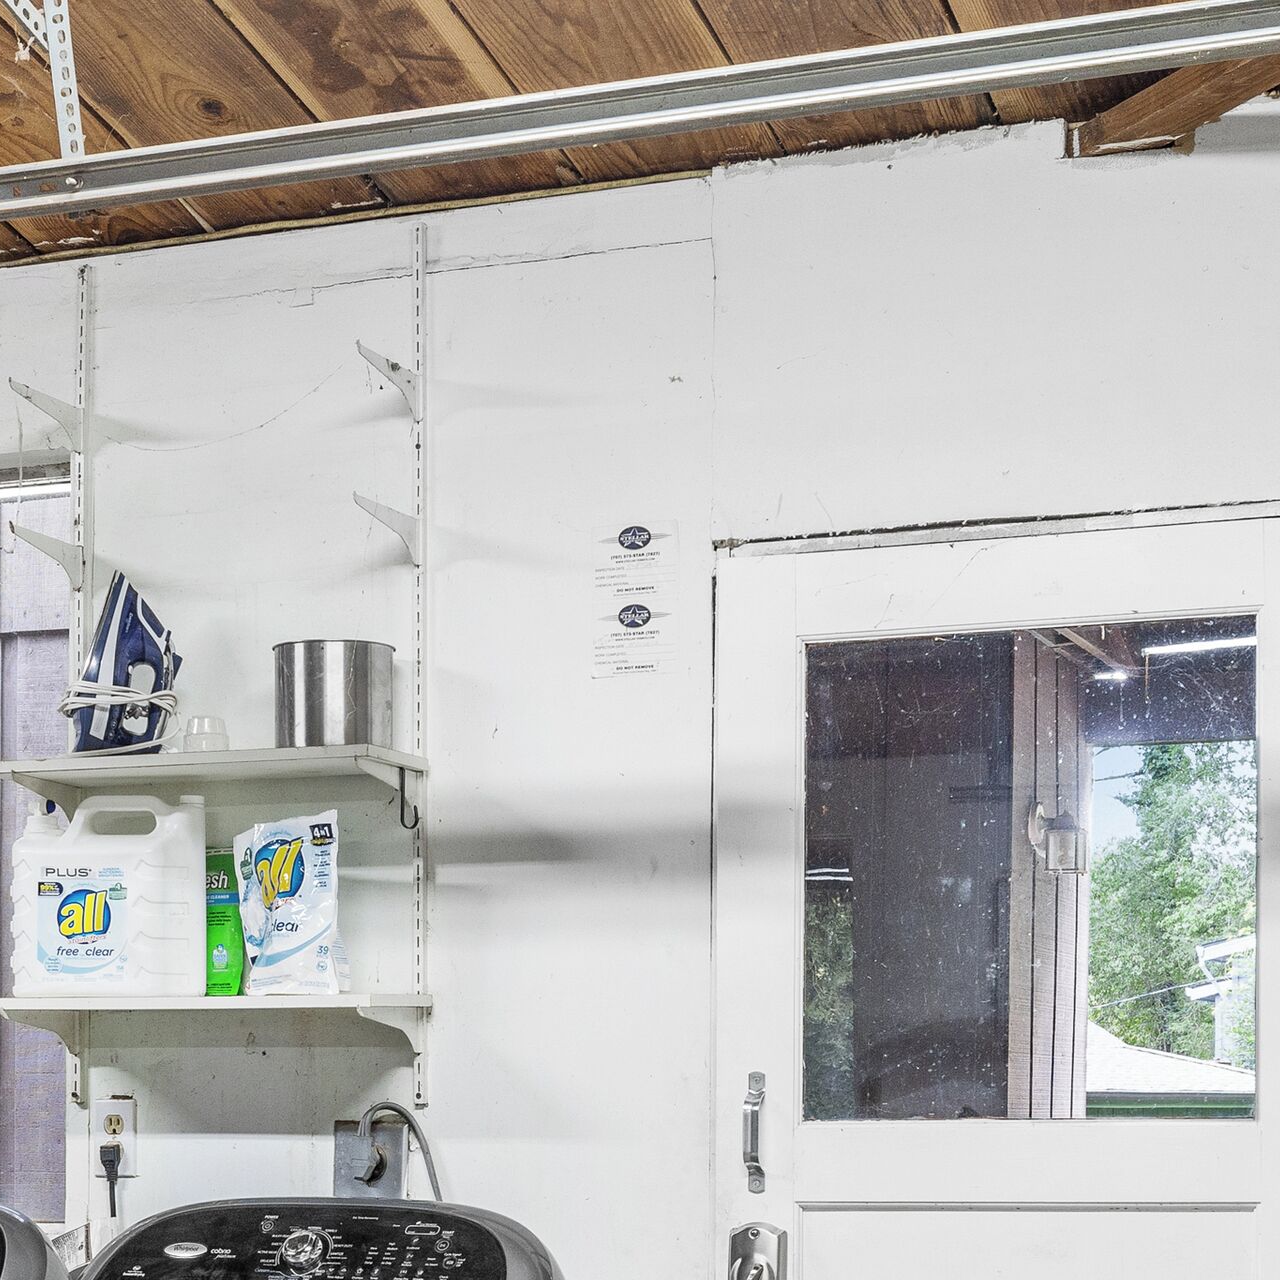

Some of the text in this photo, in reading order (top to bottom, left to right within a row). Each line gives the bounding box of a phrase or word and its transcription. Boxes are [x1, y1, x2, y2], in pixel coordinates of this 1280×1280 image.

[256, 841, 302, 909] all
[60, 890, 107, 936] all
[272, 919, 298, 932] lear
[56, 946, 115, 956] free clear
[317, 946, 328, 955] 39
